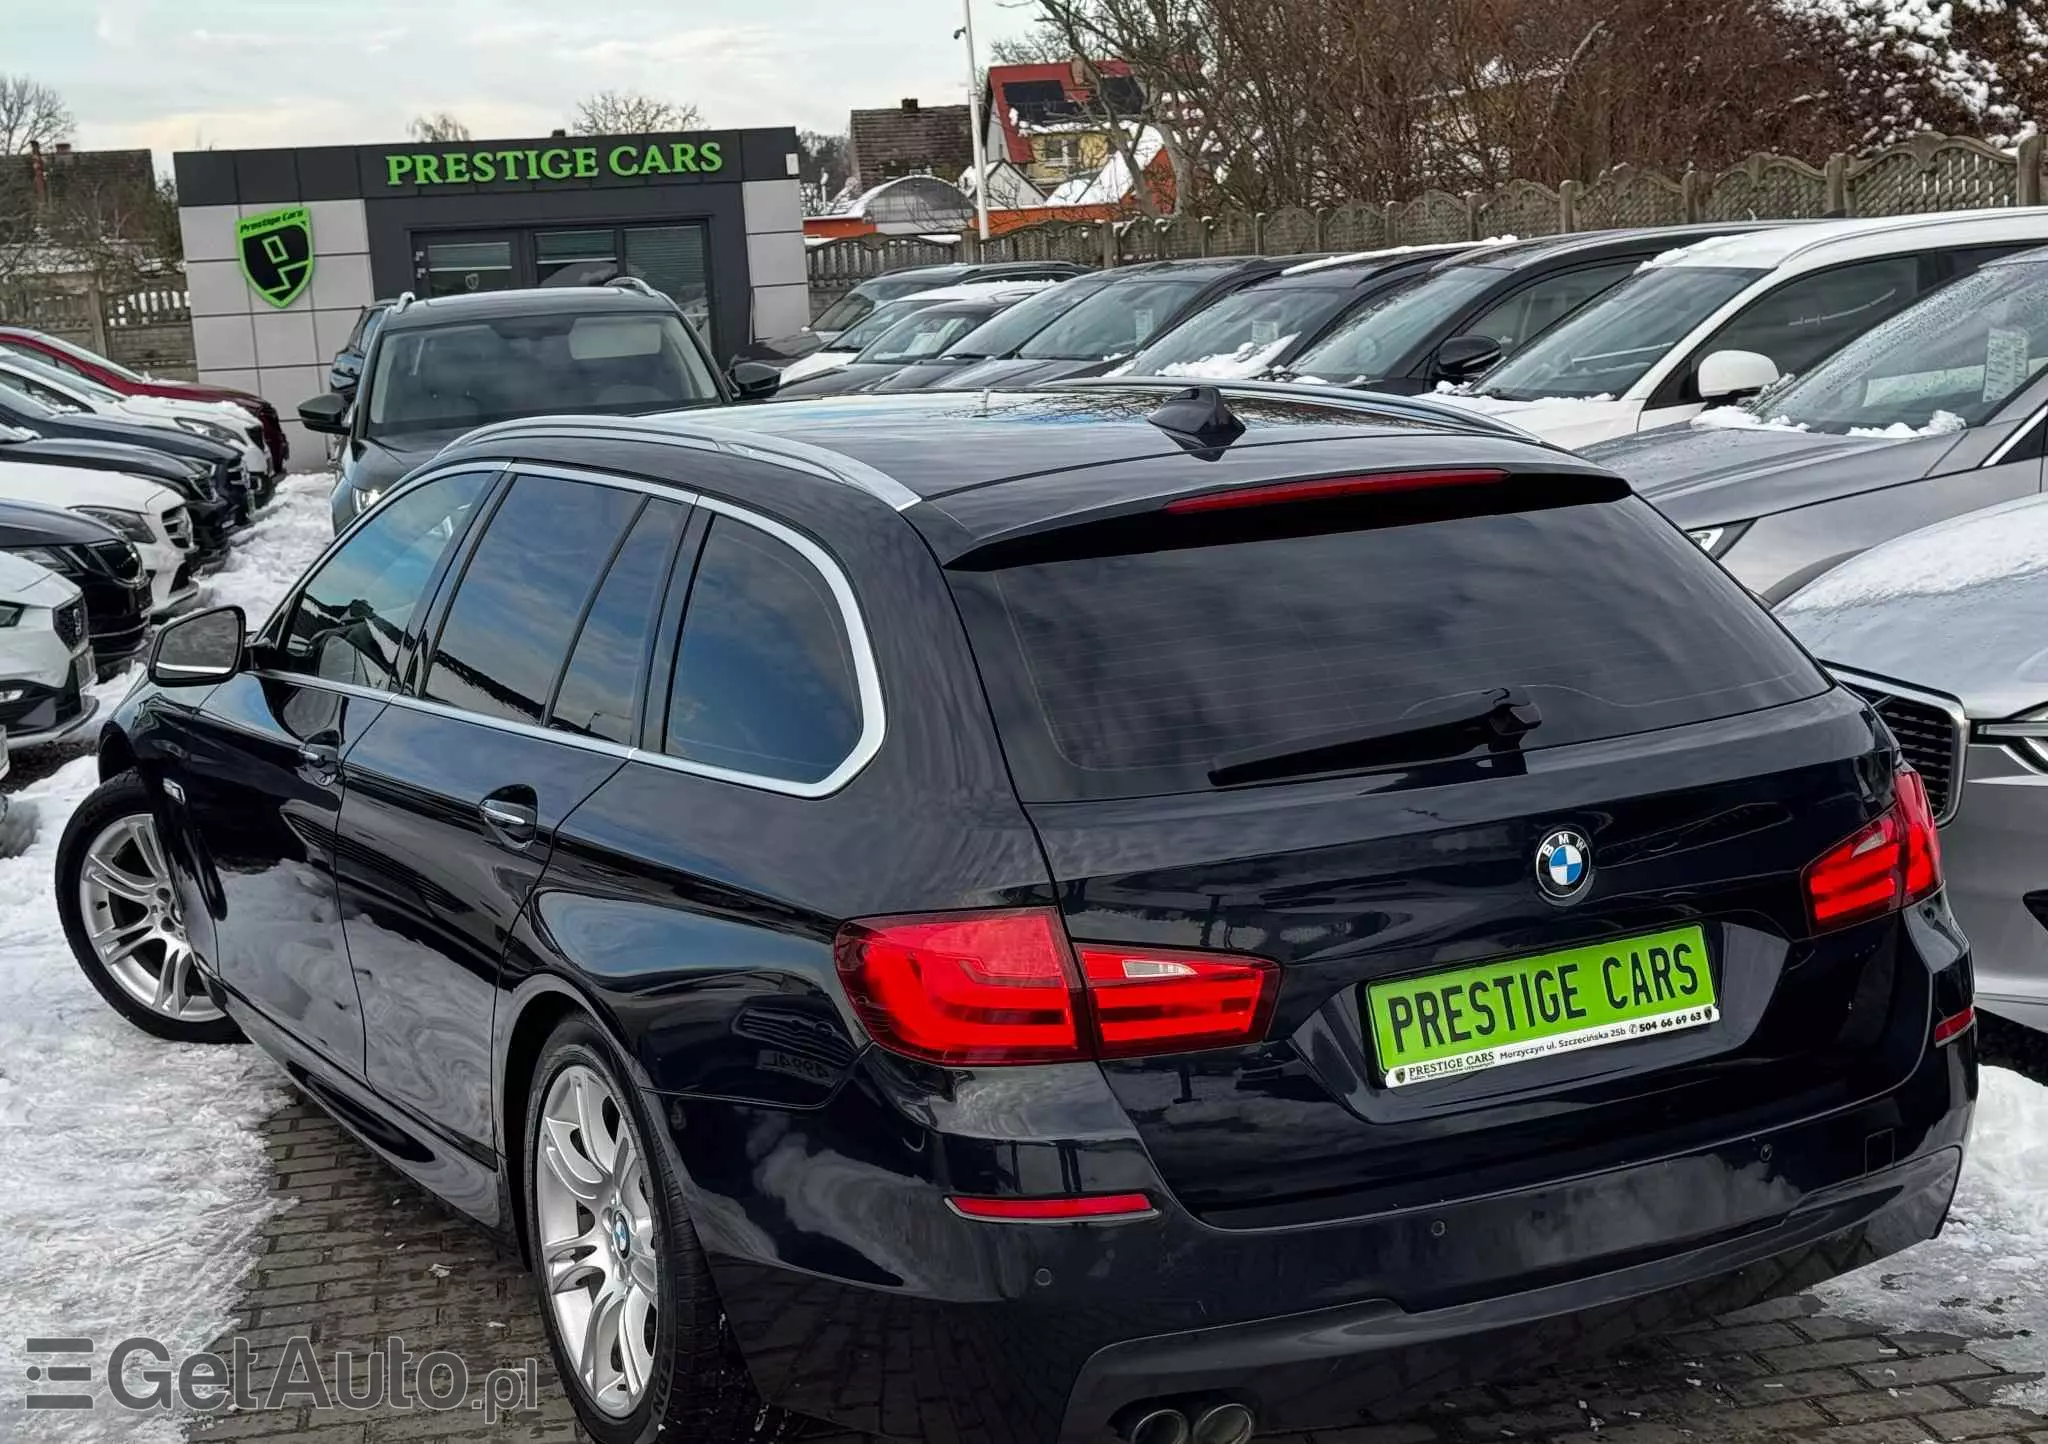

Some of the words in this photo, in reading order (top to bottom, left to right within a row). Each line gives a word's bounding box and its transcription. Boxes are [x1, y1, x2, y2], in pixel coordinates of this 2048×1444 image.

[384, 147, 599, 186] PRESTIGE
[609, 142, 723, 177] CARS
[1542, 833, 1586, 857] BMW
[1387, 963, 1587, 1054] PRESTIGE
[1601, 943, 1699, 1010] CARS
[1499, 1044, 1545, 1060] Morzyczyn
[1546, 1039, 1557, 1050] ul.
[1558, 1030, 1609, 1048] Szczecińska
[1610, 1026, 1626, 1038] 25b
[1639, 1020, 1657, 1033] 504
[1661, 1017, 1673, 1028] 66
[1675, 1014, 1687, 1025] 69
[1690, 1011, 1702, 1021] 63
[1409, 1056, 1463, 1077] PRESTIGE
[1465, 1051, 1495, 1066] CARS
